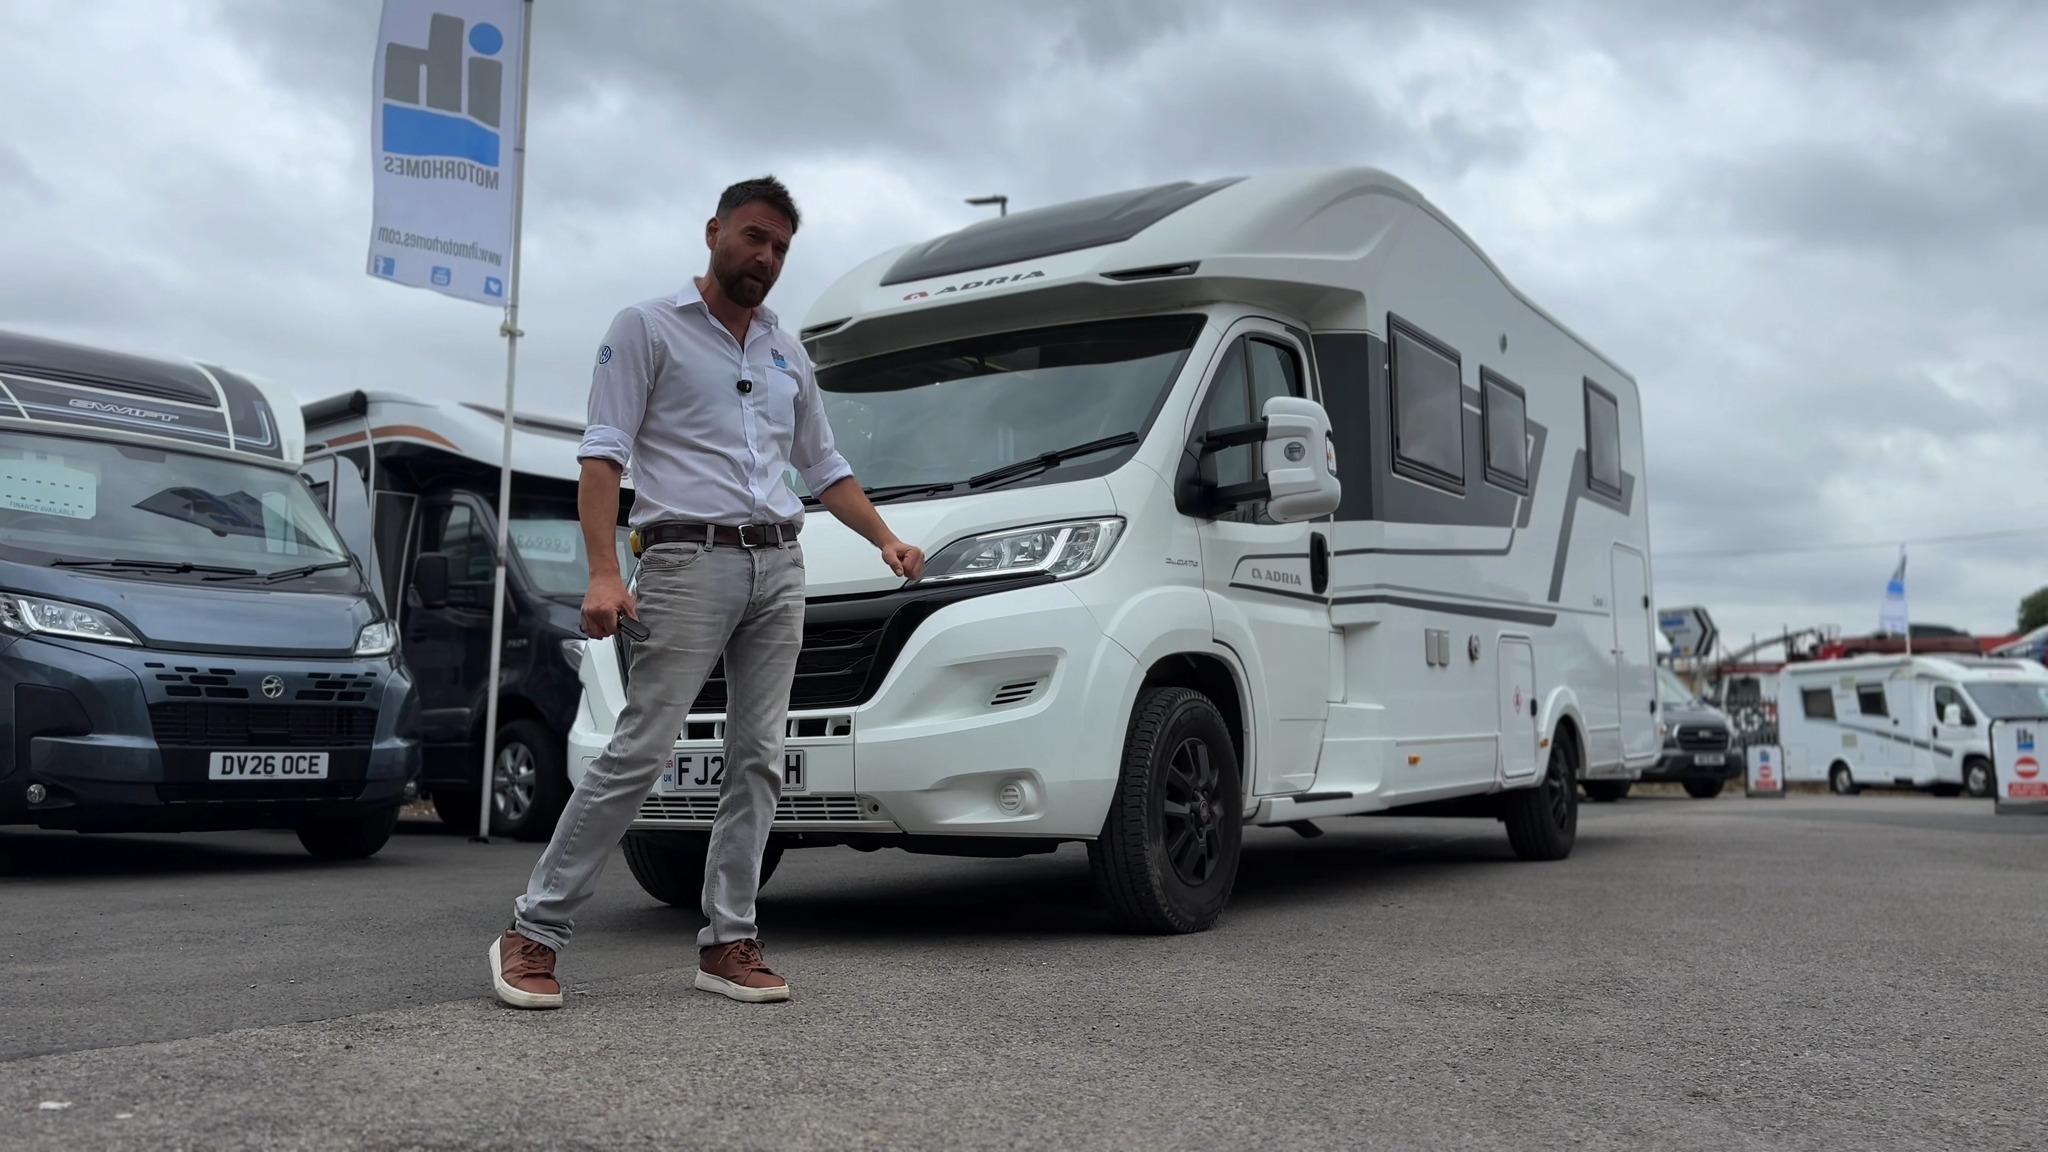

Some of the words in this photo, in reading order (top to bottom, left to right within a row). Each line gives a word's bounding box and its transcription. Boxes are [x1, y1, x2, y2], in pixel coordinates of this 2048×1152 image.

[934, 270, 1046, 295] ADRIA
[68, 398, 180, 422] SWIFT
[9, 501, 38, 511] FINANCE
[40, 505, 76, 516] AVAILABLE
[1265, 569, 1302, 585] ADRIA
[221, 754, 276, 775] DV26
[281, 754, 321, 775] OCE
[677, 755, 725, 786] FJ2
[663, 774, 672, 782] UK
